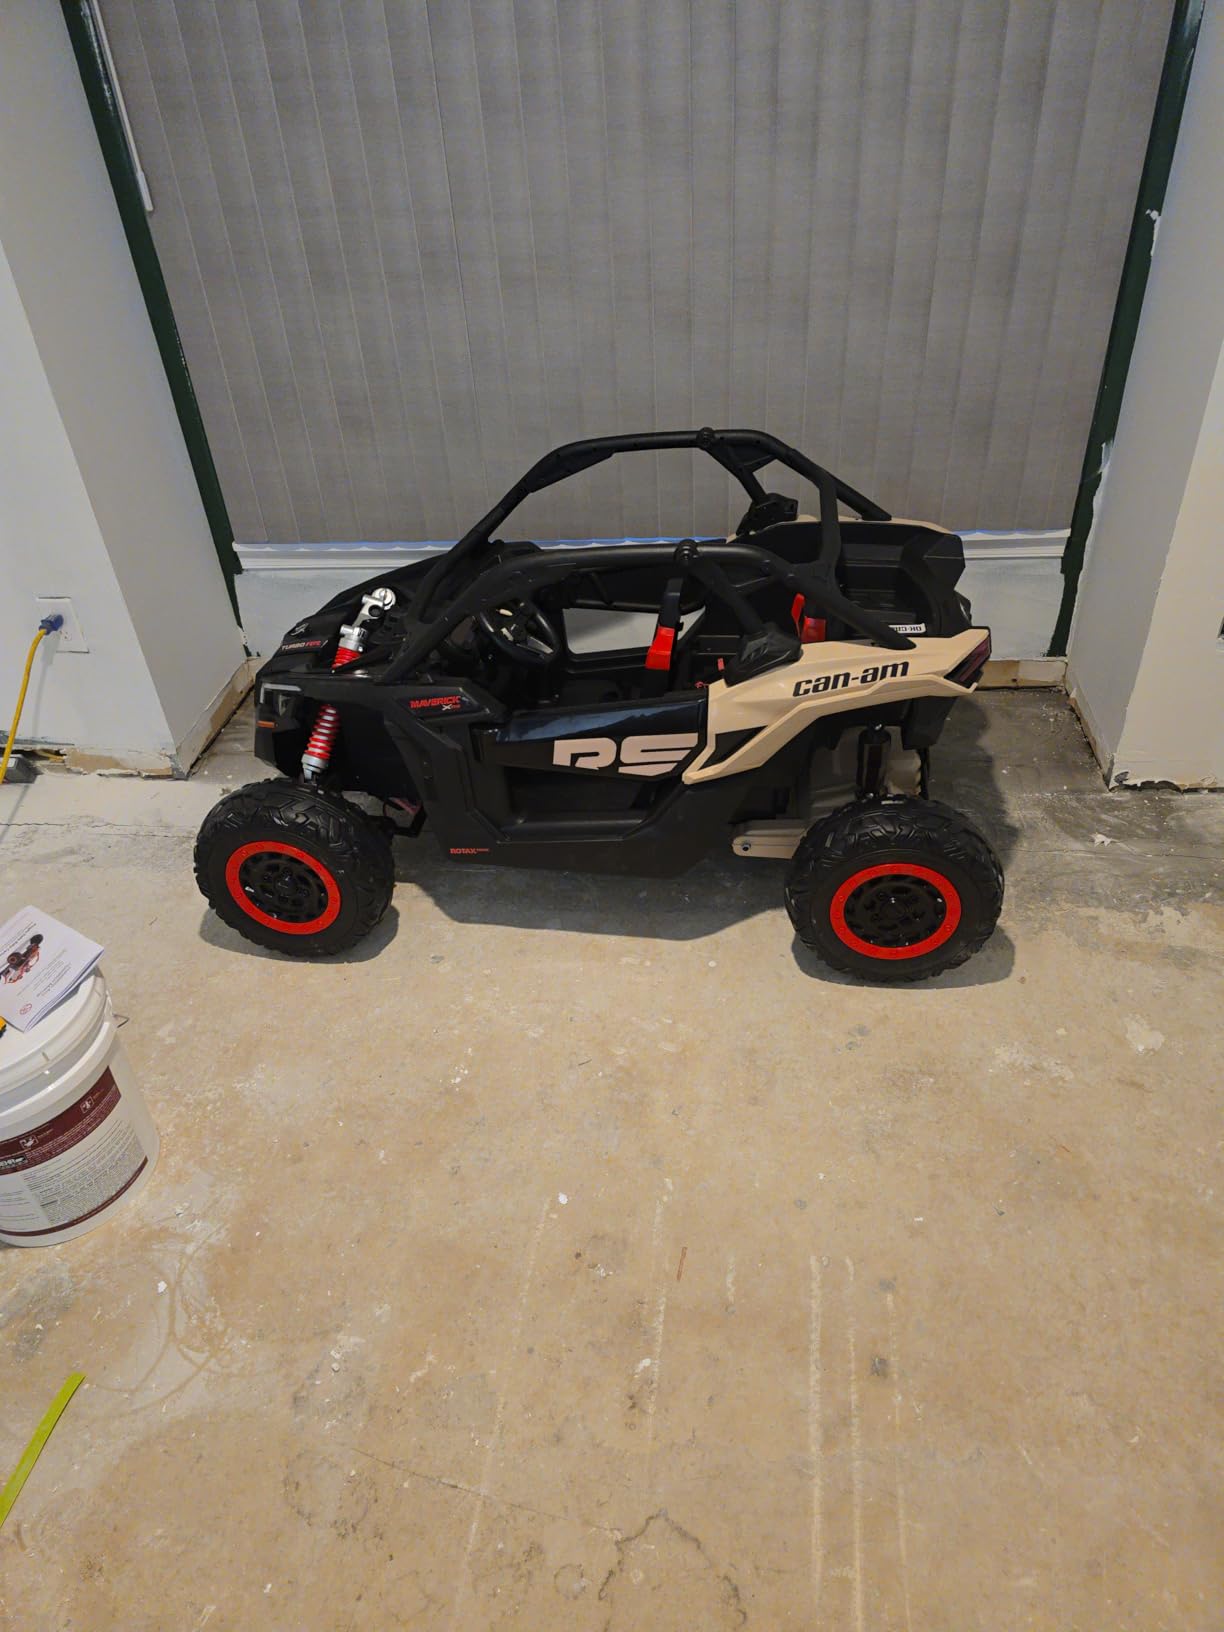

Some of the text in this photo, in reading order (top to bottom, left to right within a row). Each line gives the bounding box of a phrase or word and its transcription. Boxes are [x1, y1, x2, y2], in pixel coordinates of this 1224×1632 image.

[793, 661, 909, 697] can-am
[410, 695, 461, 708] MAVERICK
[552, 733, 698, 777] RS
